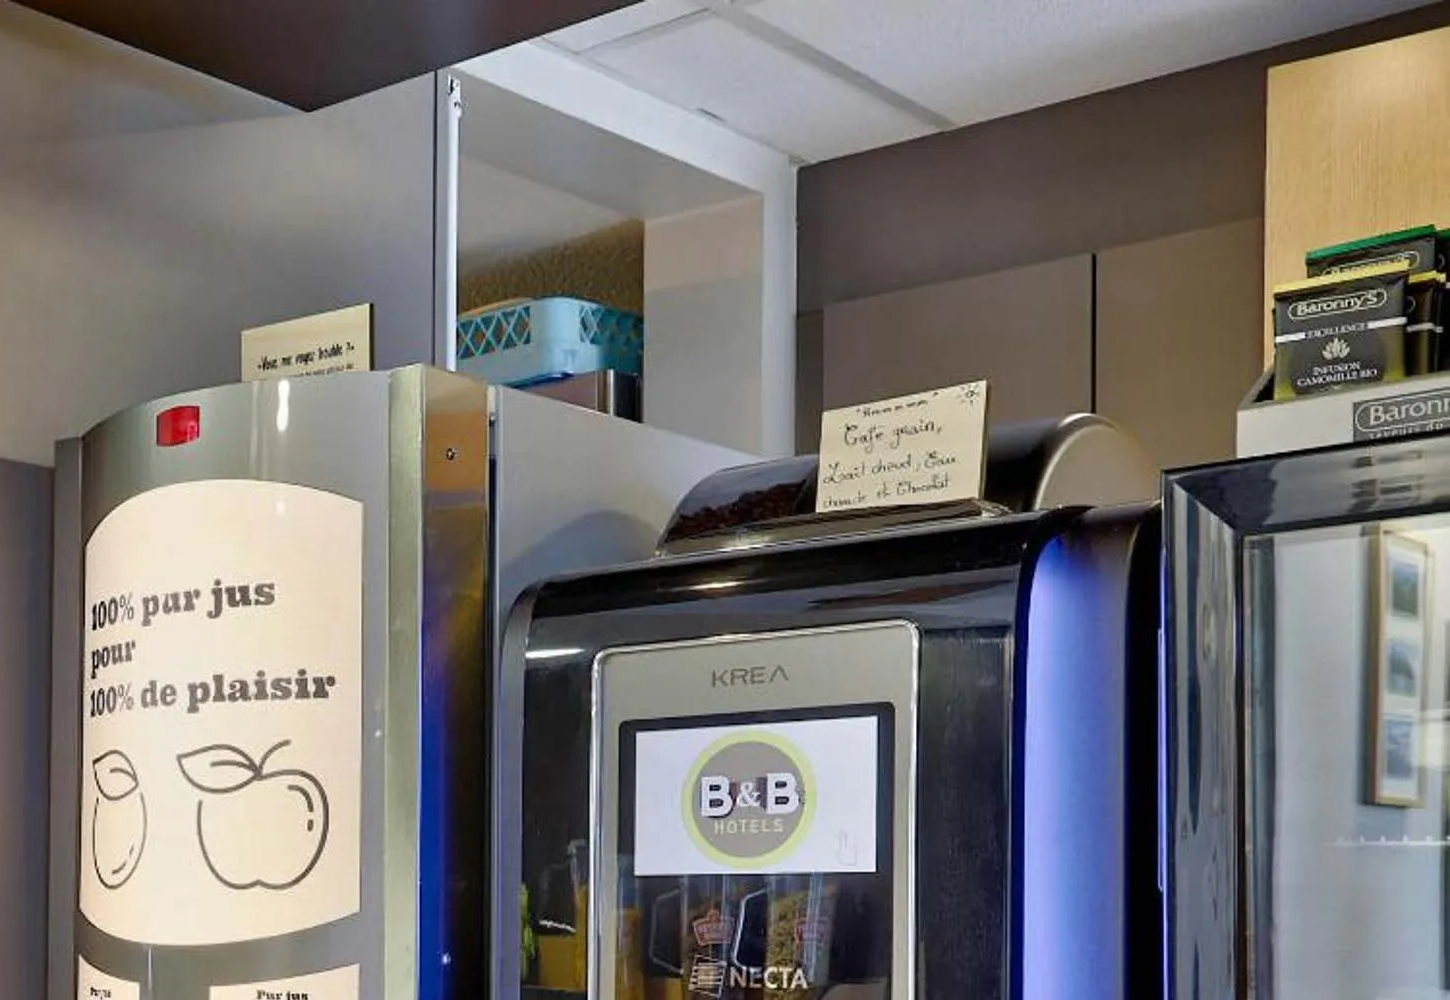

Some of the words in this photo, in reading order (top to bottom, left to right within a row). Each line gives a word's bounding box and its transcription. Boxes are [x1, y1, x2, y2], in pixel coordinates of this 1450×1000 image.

[91, 592, 135, 631] 100%
[142, 588, 201, 627] pur
[207, 578, 276, 619] jus
[90, 640, 136, 679] pour
[90, 683, 134, 718] 100%
[141, 680, 177, 709] de
[187, 669, 336, 714] plaisir
[701, 772, 800, 818] B&B
[713, 818, 784, 835] HOTELS
[256, 989, 283, 1000] Pur
[730, 967, 808, 990] NECTA
